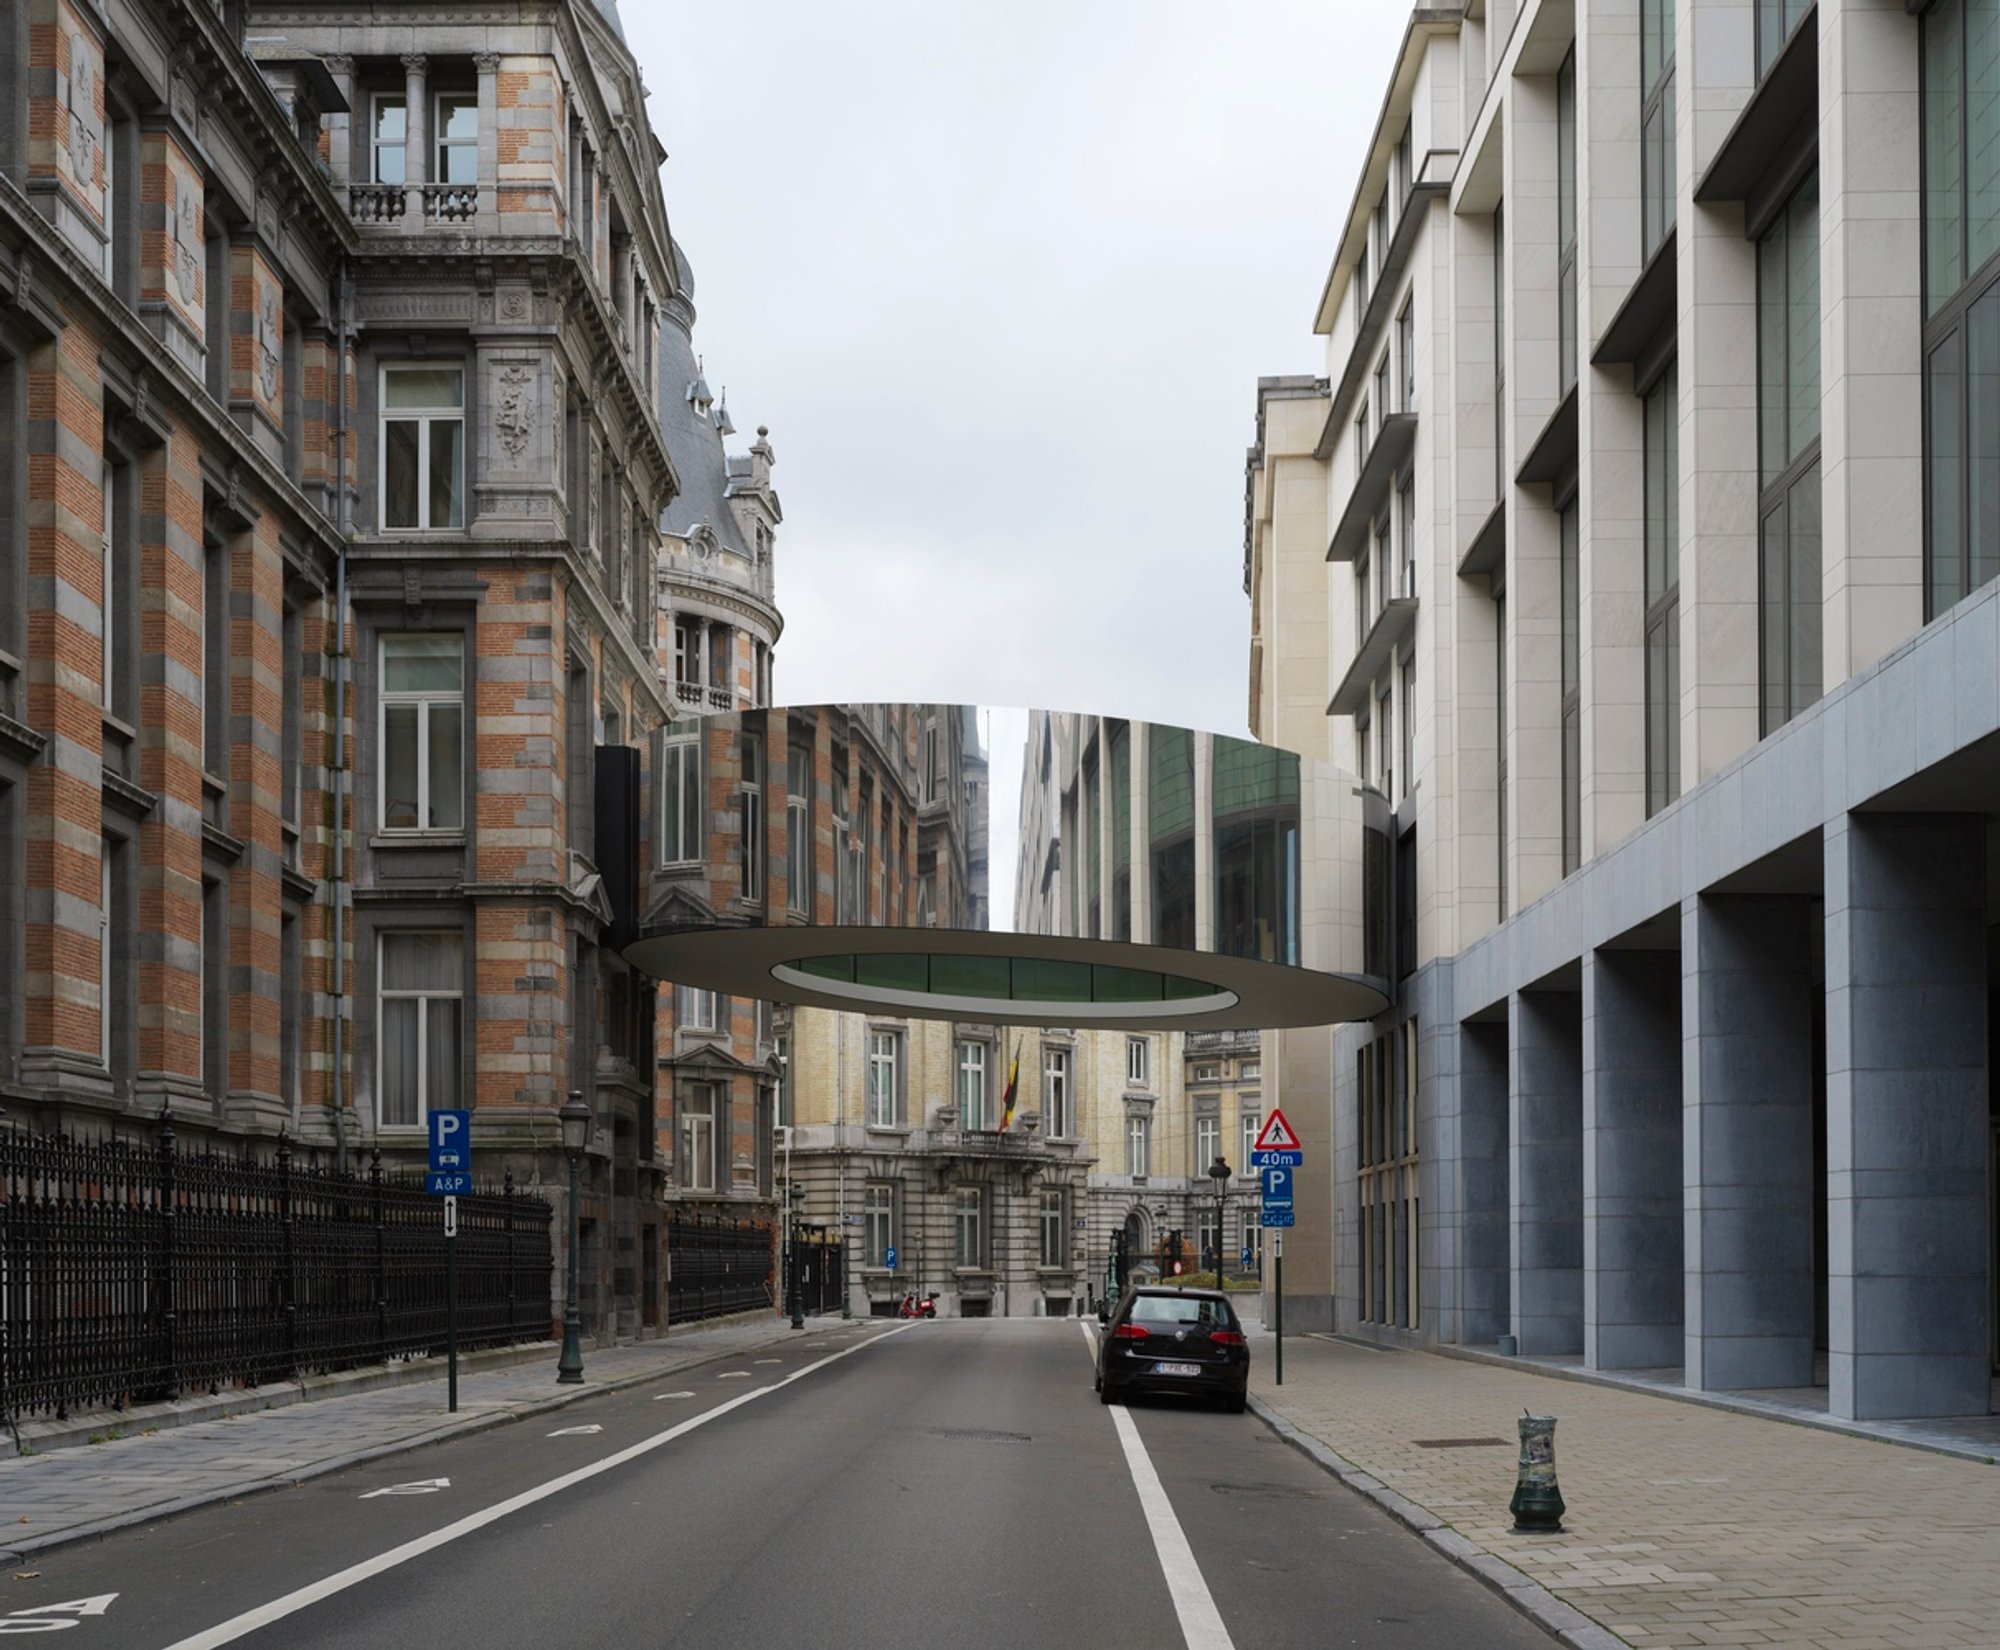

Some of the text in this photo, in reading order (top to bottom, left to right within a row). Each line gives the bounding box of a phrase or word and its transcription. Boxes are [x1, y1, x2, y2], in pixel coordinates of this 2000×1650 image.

[437, 1114, 460, 1146] P
[1261, 1153, 1294, 1165] 40m
[435, 1177, 463, 1191] A&P
[1270, 1170, 1285, 1193] P
[887, 1250, 895, 1261] P
